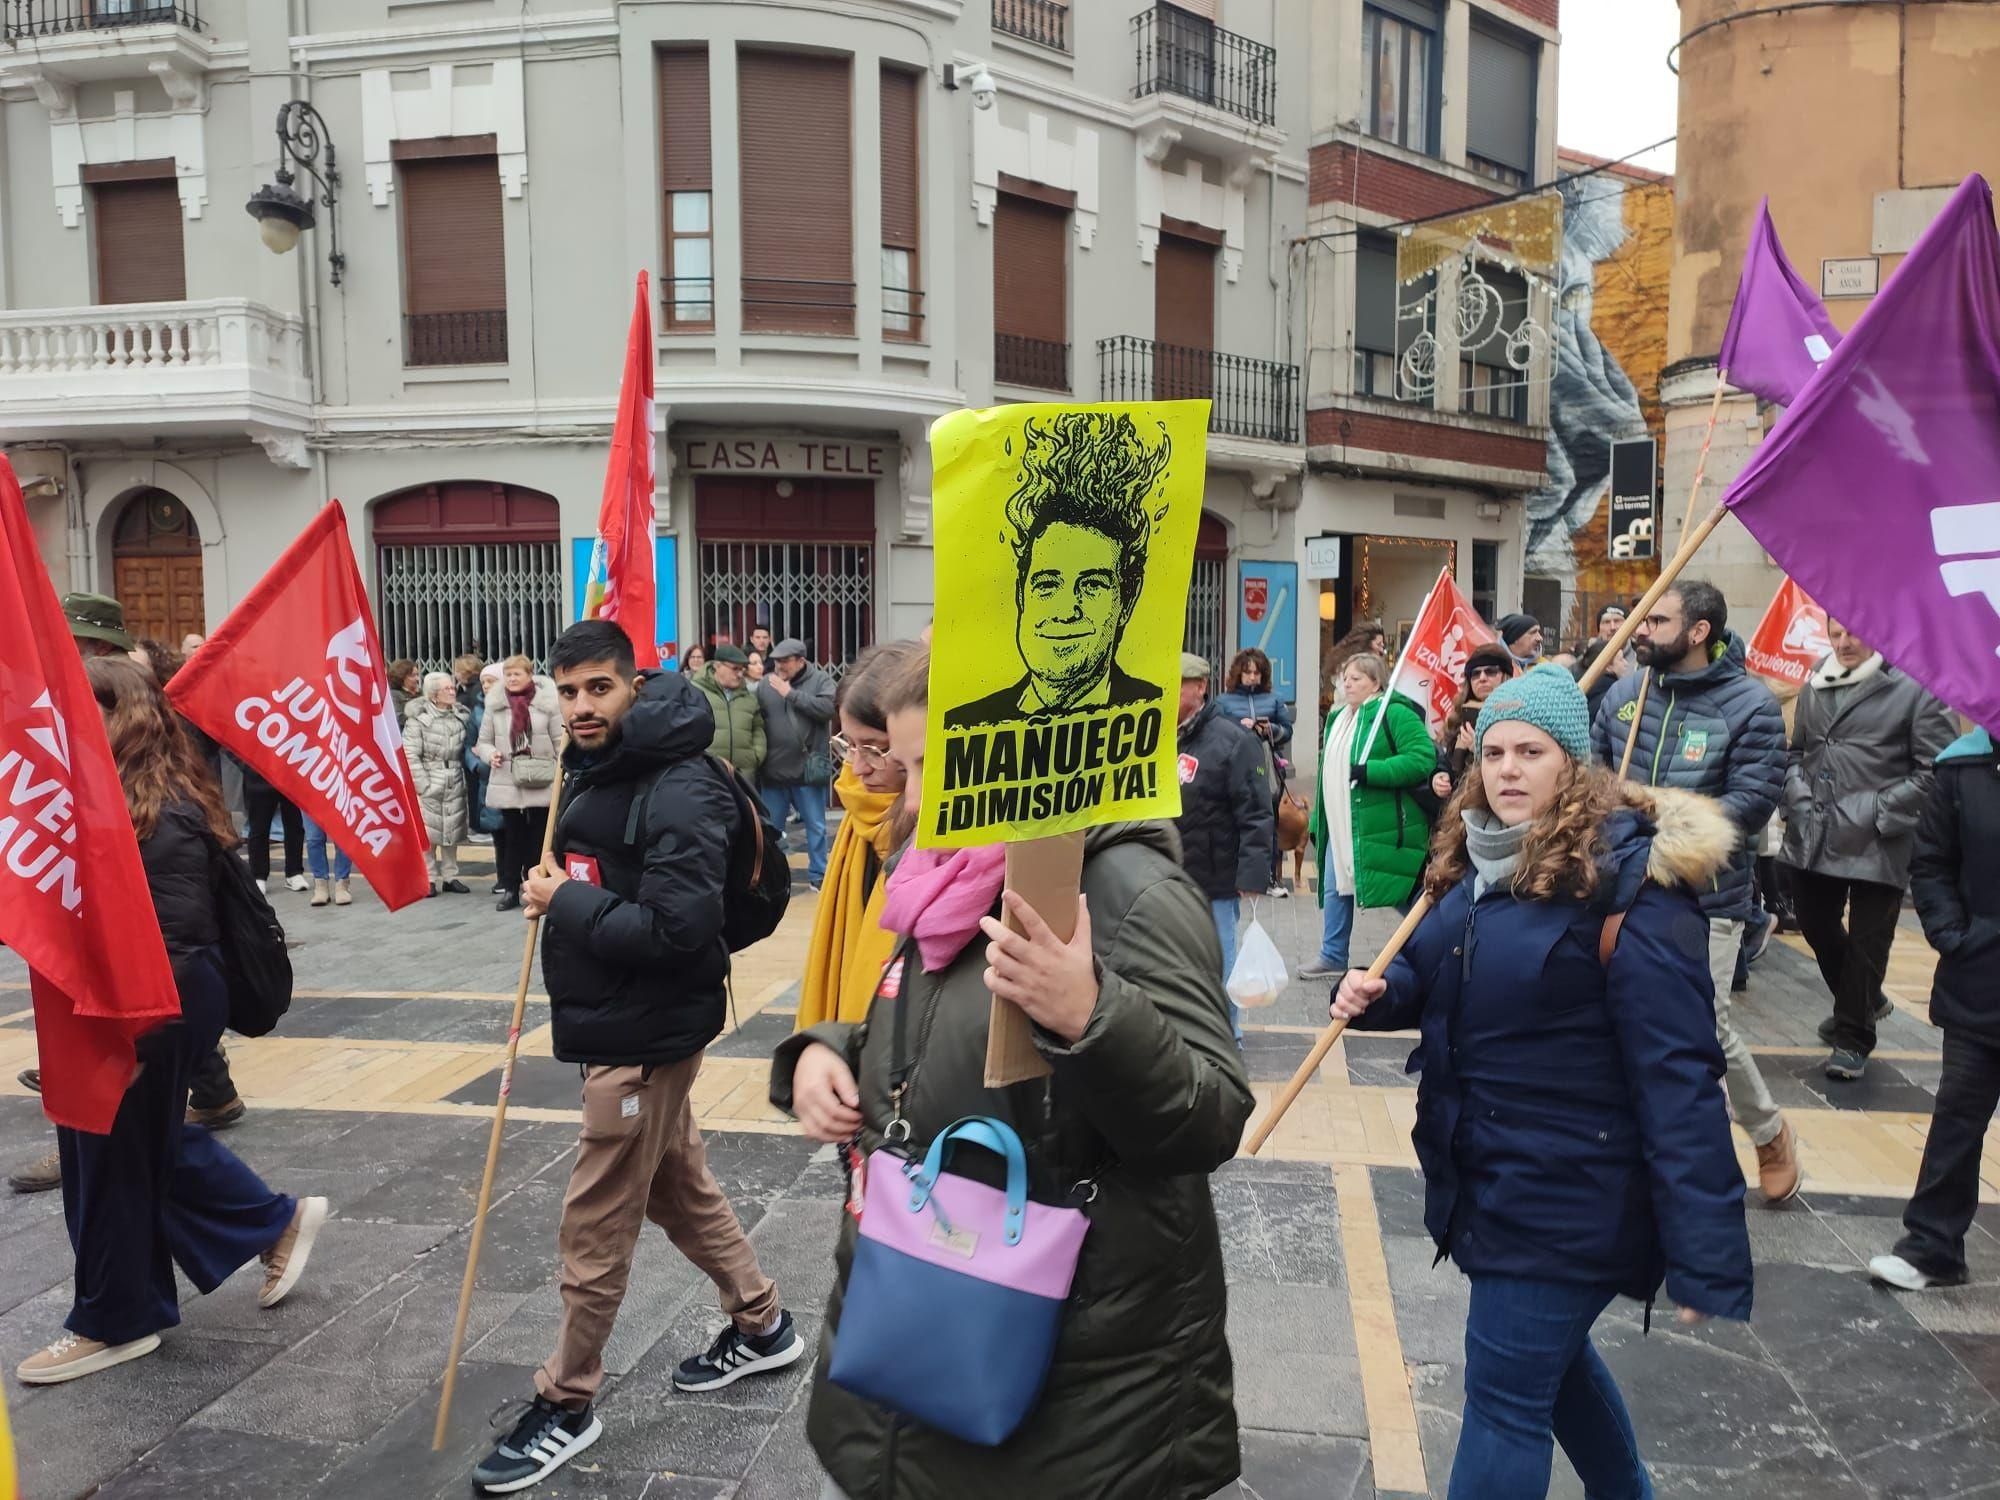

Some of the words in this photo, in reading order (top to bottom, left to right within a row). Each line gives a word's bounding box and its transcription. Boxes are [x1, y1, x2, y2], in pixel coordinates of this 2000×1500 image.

[686, 441, 780, 470] CASA
[799, 443, 884, 475] TELE
[234, 696, 393, 858] COMUNISTA
[271, 676, 405, 825] JUVENTUD
[943, 707, 1162, 791] MAÑUECO
[935, 770, 1108, 836] ¡DIMISIÓN
[1112, 761, 1157, 801] YA!
